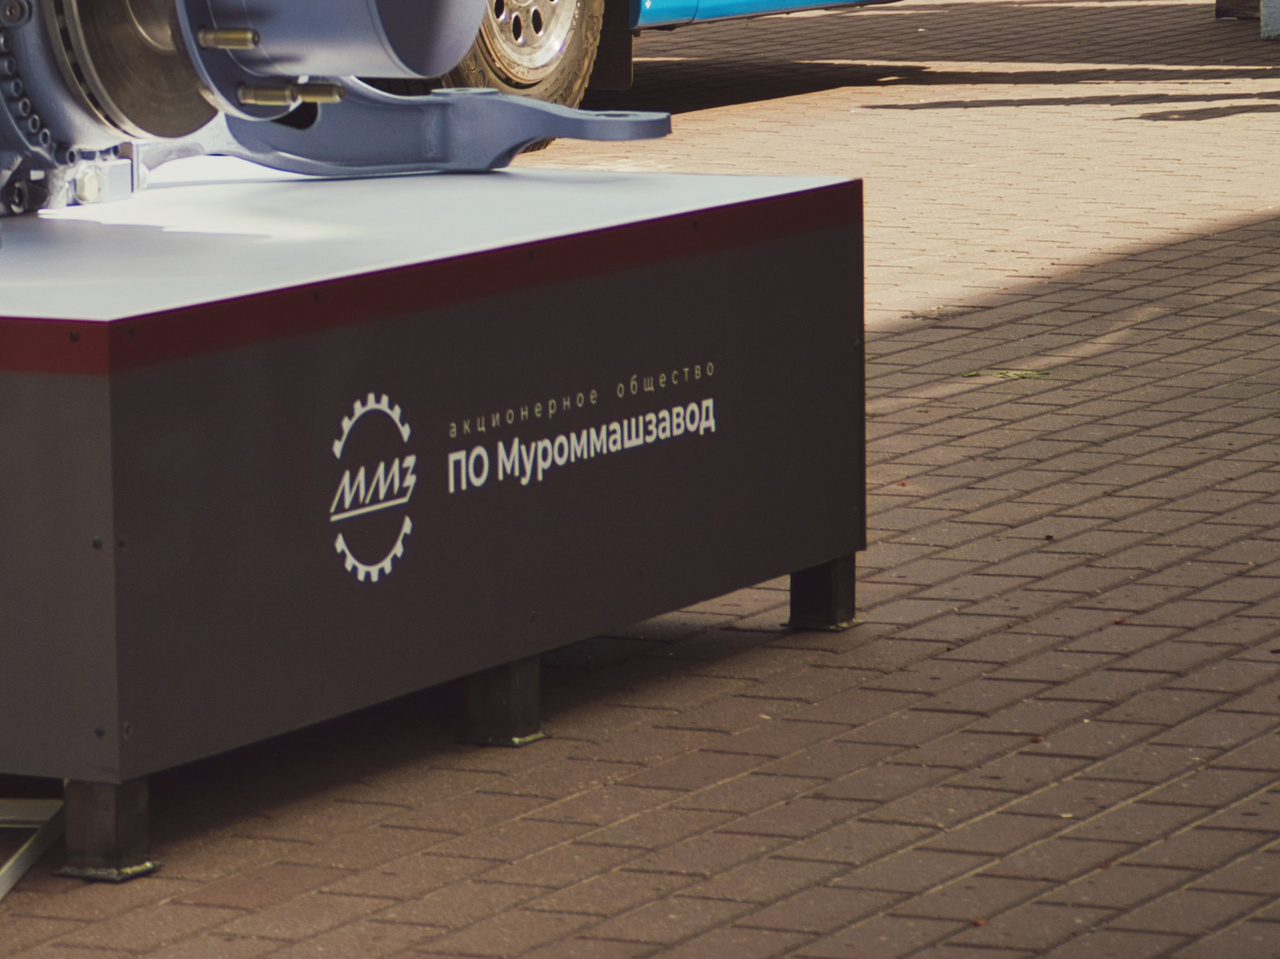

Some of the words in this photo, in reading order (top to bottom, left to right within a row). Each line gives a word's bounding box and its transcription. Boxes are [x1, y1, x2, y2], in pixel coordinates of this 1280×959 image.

[448, 388, 598, 438] акционерное
[616, 361, 715, 399] общество
[448, 445, 490, 494] ПО
[497, 397, 716, 486] Муроммашзавод
[330, 454, 417, 522] ММЗ
